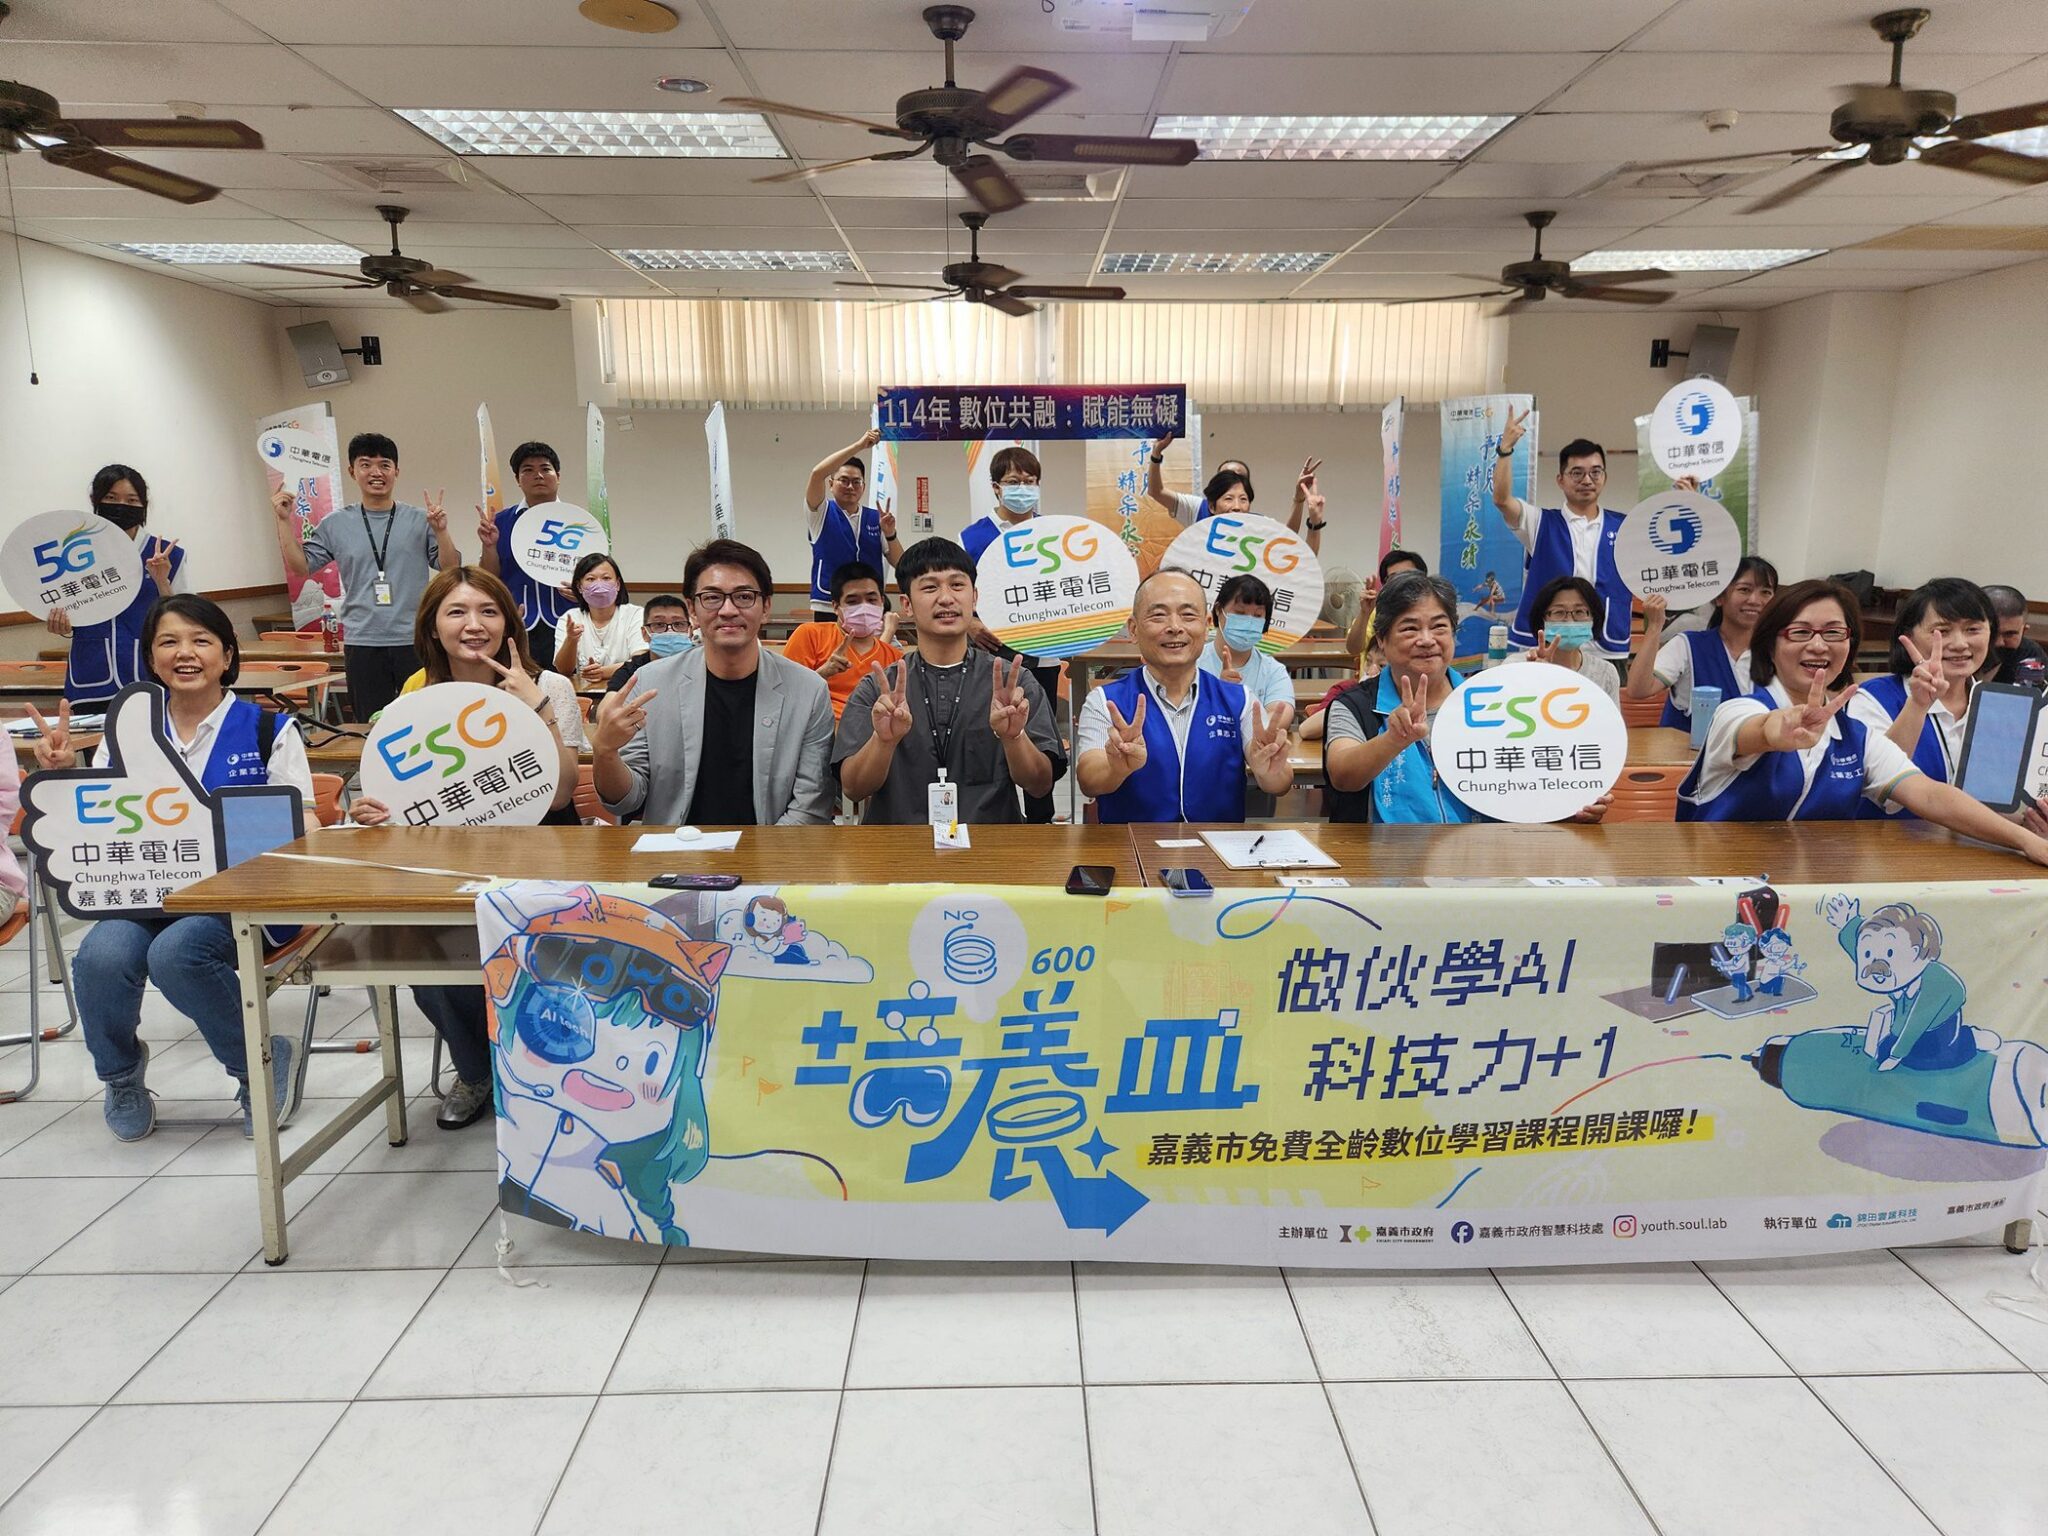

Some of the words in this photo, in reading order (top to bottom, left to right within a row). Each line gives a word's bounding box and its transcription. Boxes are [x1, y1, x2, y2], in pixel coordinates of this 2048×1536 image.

[883, 394, 951, 429] 114年
[959, 393, 1179, 430] 數位共融：賦能無礙
[290, 446, 332, 463] 中華電信
[1667, 440, 1725, 459] 中華電信
[1668, 460, 1700, 470] Chunghwa
[1701, 456, 1725, 465] Telecom
[536, 520, 584, 550] 5G
[1003, 524, 1099, 575] ESG
[1205, 516, 1300, 575] ESG
[33, 538, 96, 584] 5G
[560, 566, 574, 574] Telec
[1641, 559, 1719, 583] 中華電信
[40, 566, 122, 605] 中華電信
[64, 597, 94, 612] nghwa
[94, 584, 128, 600] Telecom
[1004, 570, 1112, 608] 中華電信
[1190, 568, 1295, 612] 中信
[1643, 584, 1686, 595] Chunghwa
[1686, 579, 1720, 590] Telecom
[1008, 606, 1068, 624] Chunghwa
[1069, 599, 1114, 616] Telecom
[1463, 685, 1591, 739] ESG
[377, 697, 508, 782] ESG
[1456, 743, 1602, 774] 中華電信
[403, 748, 544, 826] 中華電信
[493, 781, 554, 815] Telecom
[1457, 779, 1537, 795] Chunghwa
[1539, 777, 1604, 791] Telecom
[75, 784, 190, 835] ESG
[72, 838, 201, 866] 中華電信
[74, 871, 146, 886] Chunghwa
[147, 869, 202, 881] Telecom
[1031, 944, 1096, 975] 600
[1277, 938, 1577, 1013] 做伙學AI
[540, 1008, 556, 1022] AI
[1303, 1026, 1617, 1101] 科技力+1
[794, 980, 1260, 1238] 培養皿
[1278, 1226, 1328, 1240] 主辦單位
[1376, 1225, 1434, 1237] 嘉義市政府
[1478, 1222, 1604, 1239] 嘉義市政府智慧科技處
[1641, 1218, 1727, 1235] youth.soul.lab
[1763, 1216, 1817, 1230] 執行單位
